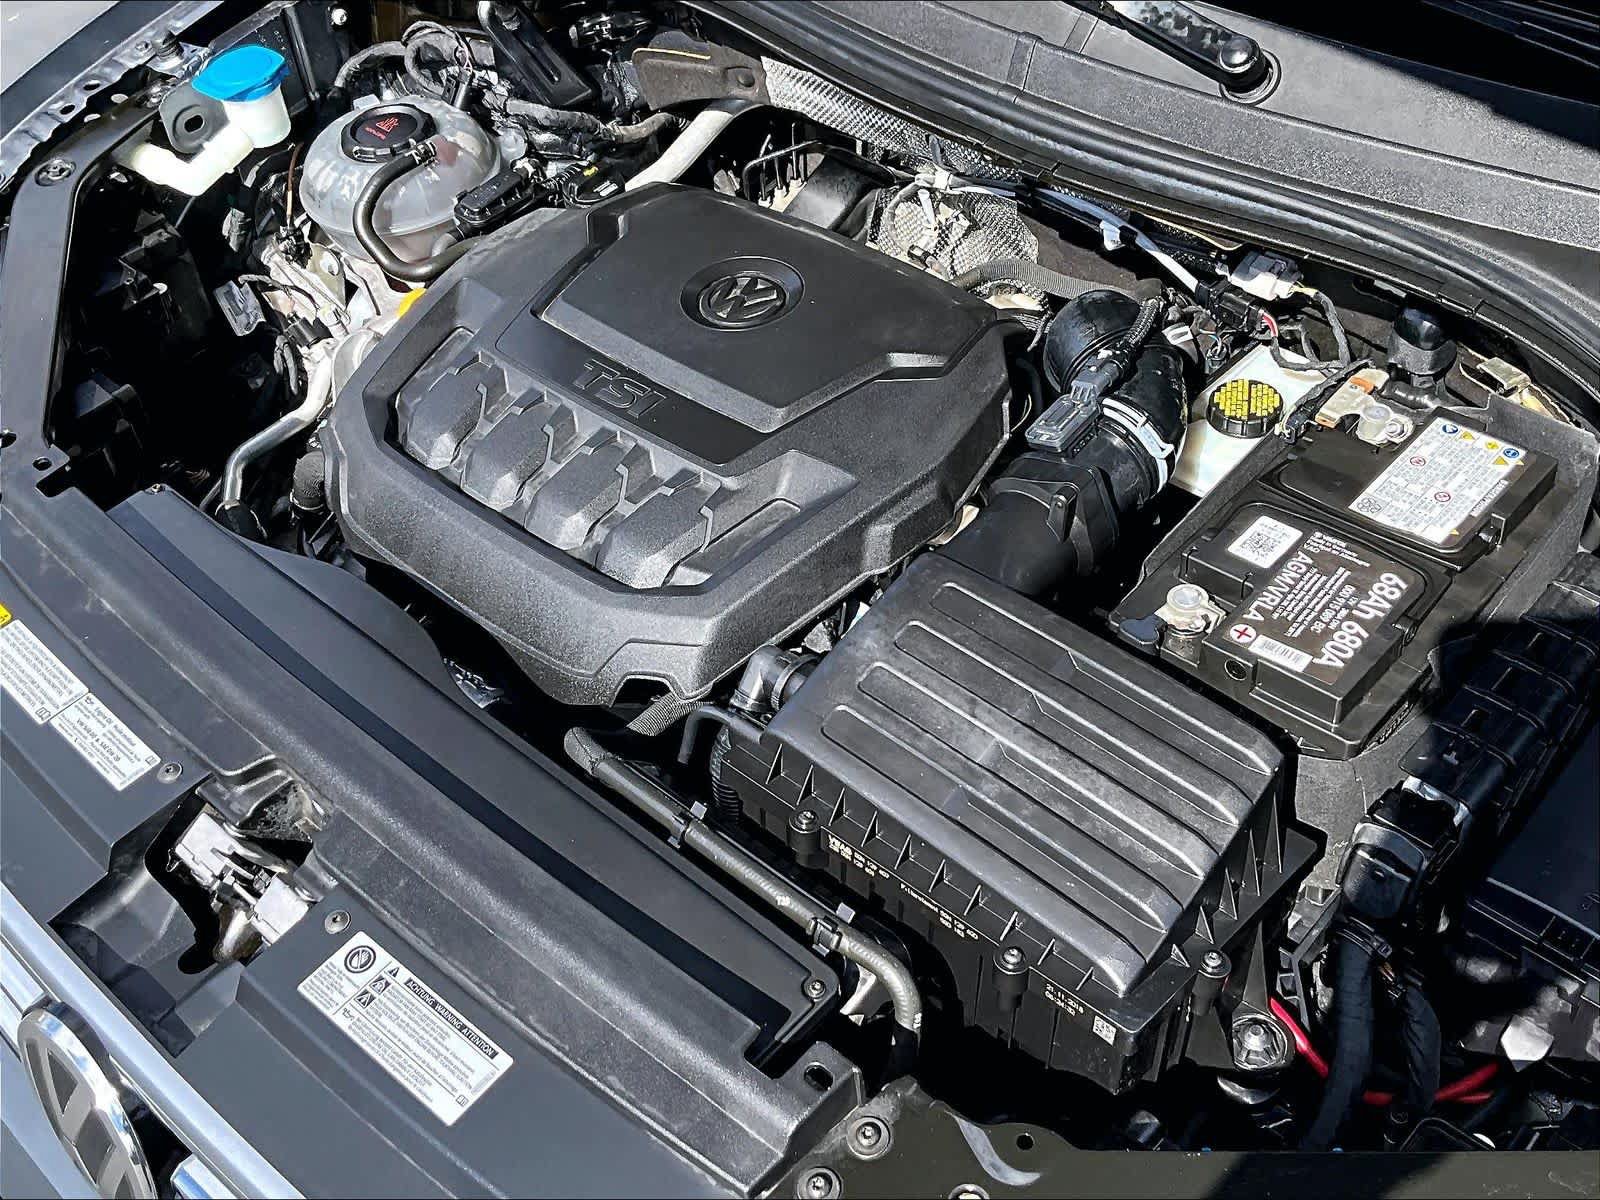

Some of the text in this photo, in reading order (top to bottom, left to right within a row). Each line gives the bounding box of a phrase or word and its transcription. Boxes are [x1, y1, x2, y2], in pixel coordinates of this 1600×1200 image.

[572, 359, 667, 419] TSI
[1243, 551, 1315, 622] AGM/VRLA
[1329, 597, 1346, 612] 915
[1352, 573, 1408, 620] 68Ah
[1310, 620, 1327, 634] BC
[1312, 621, 1370, 668] 680A
[407, 980, 436, 1006] ACHTUNG
[434, 1003, 463, 1029] WARNING
[461, 1026, 495, 1056] ATTENTION
